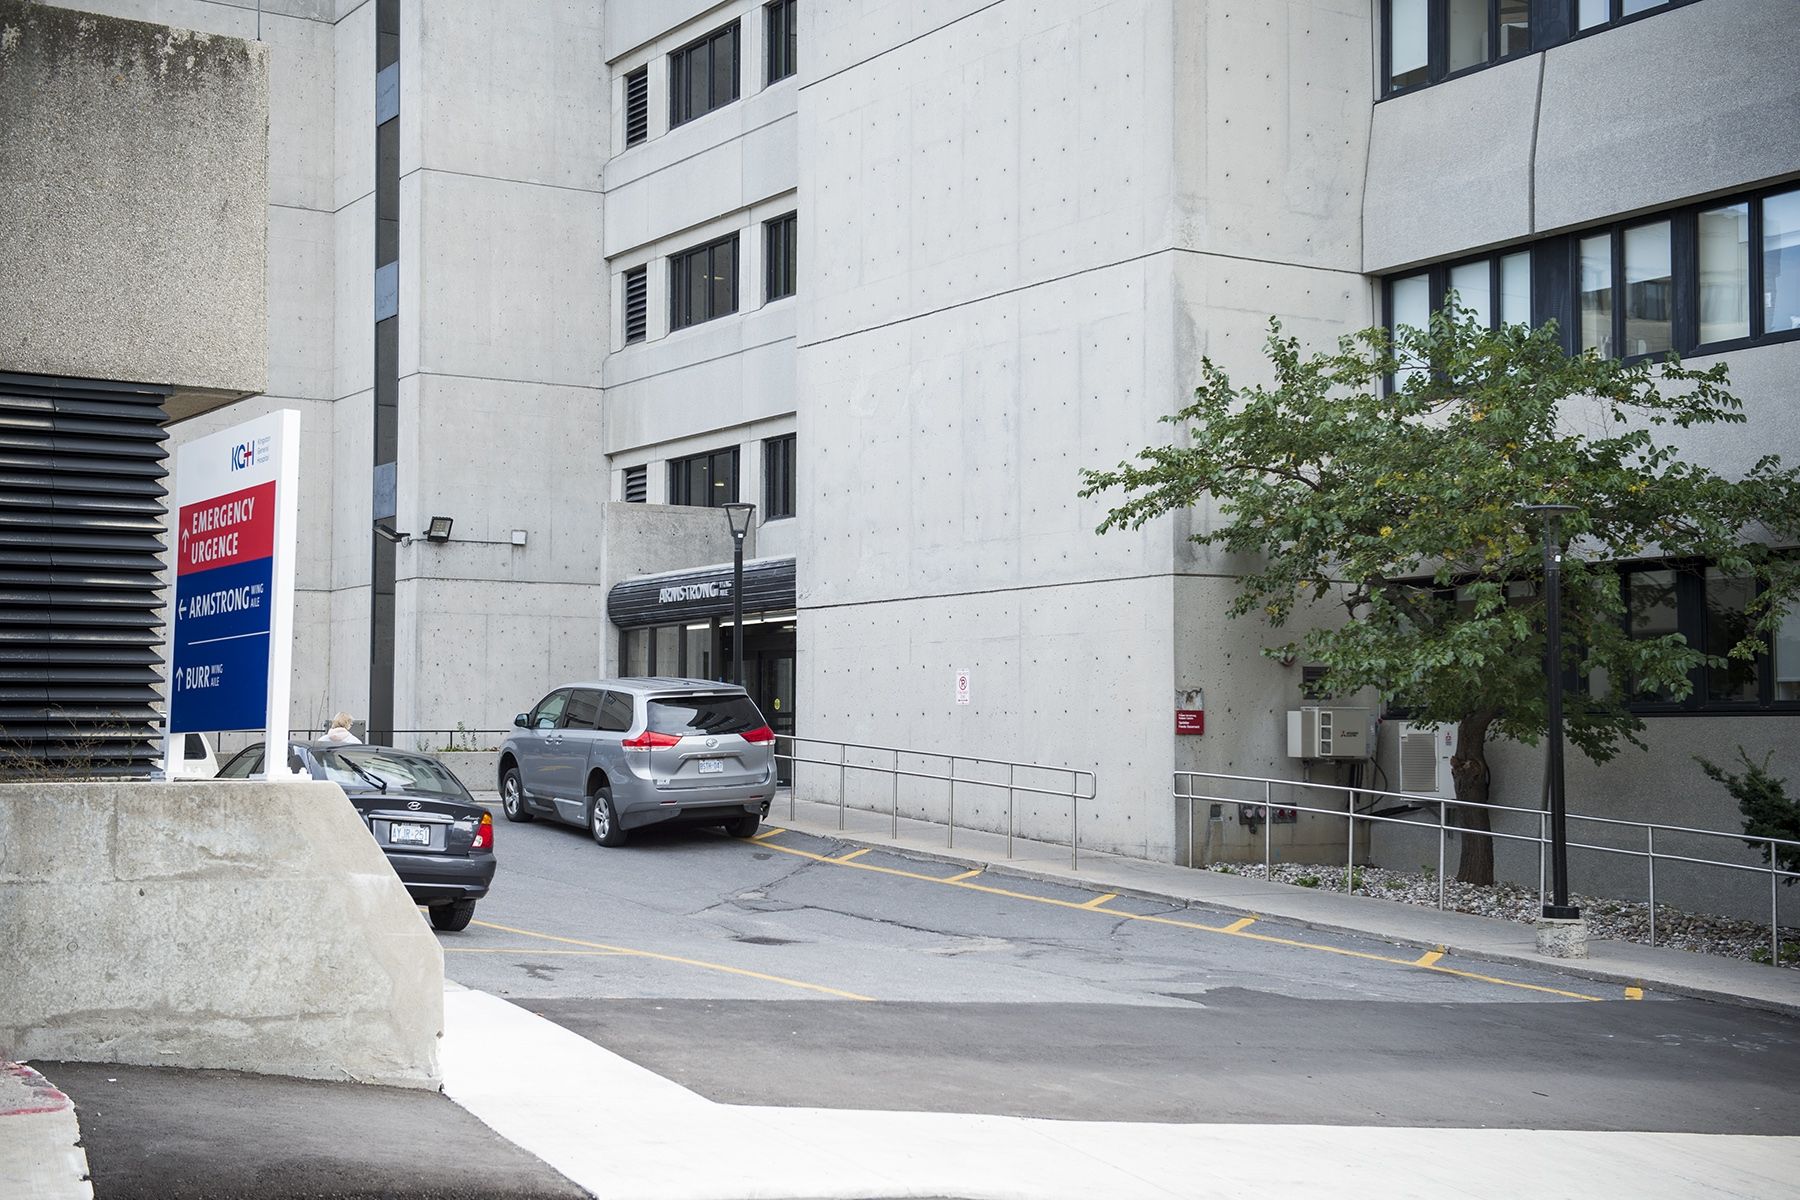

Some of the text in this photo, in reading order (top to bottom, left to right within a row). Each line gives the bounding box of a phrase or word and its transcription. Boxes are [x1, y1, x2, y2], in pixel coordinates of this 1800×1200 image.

[192, 497, 255, 535] EMERGENCY
[191, 532, 239, 565] URGENCE
[188, 583, 264, 619] ARMSTRONG WING
[250, 597, 261, 608] AILE
[658, 581, 719, 604] ARMSTRONG
[185, 665, 210, 690] BURR
